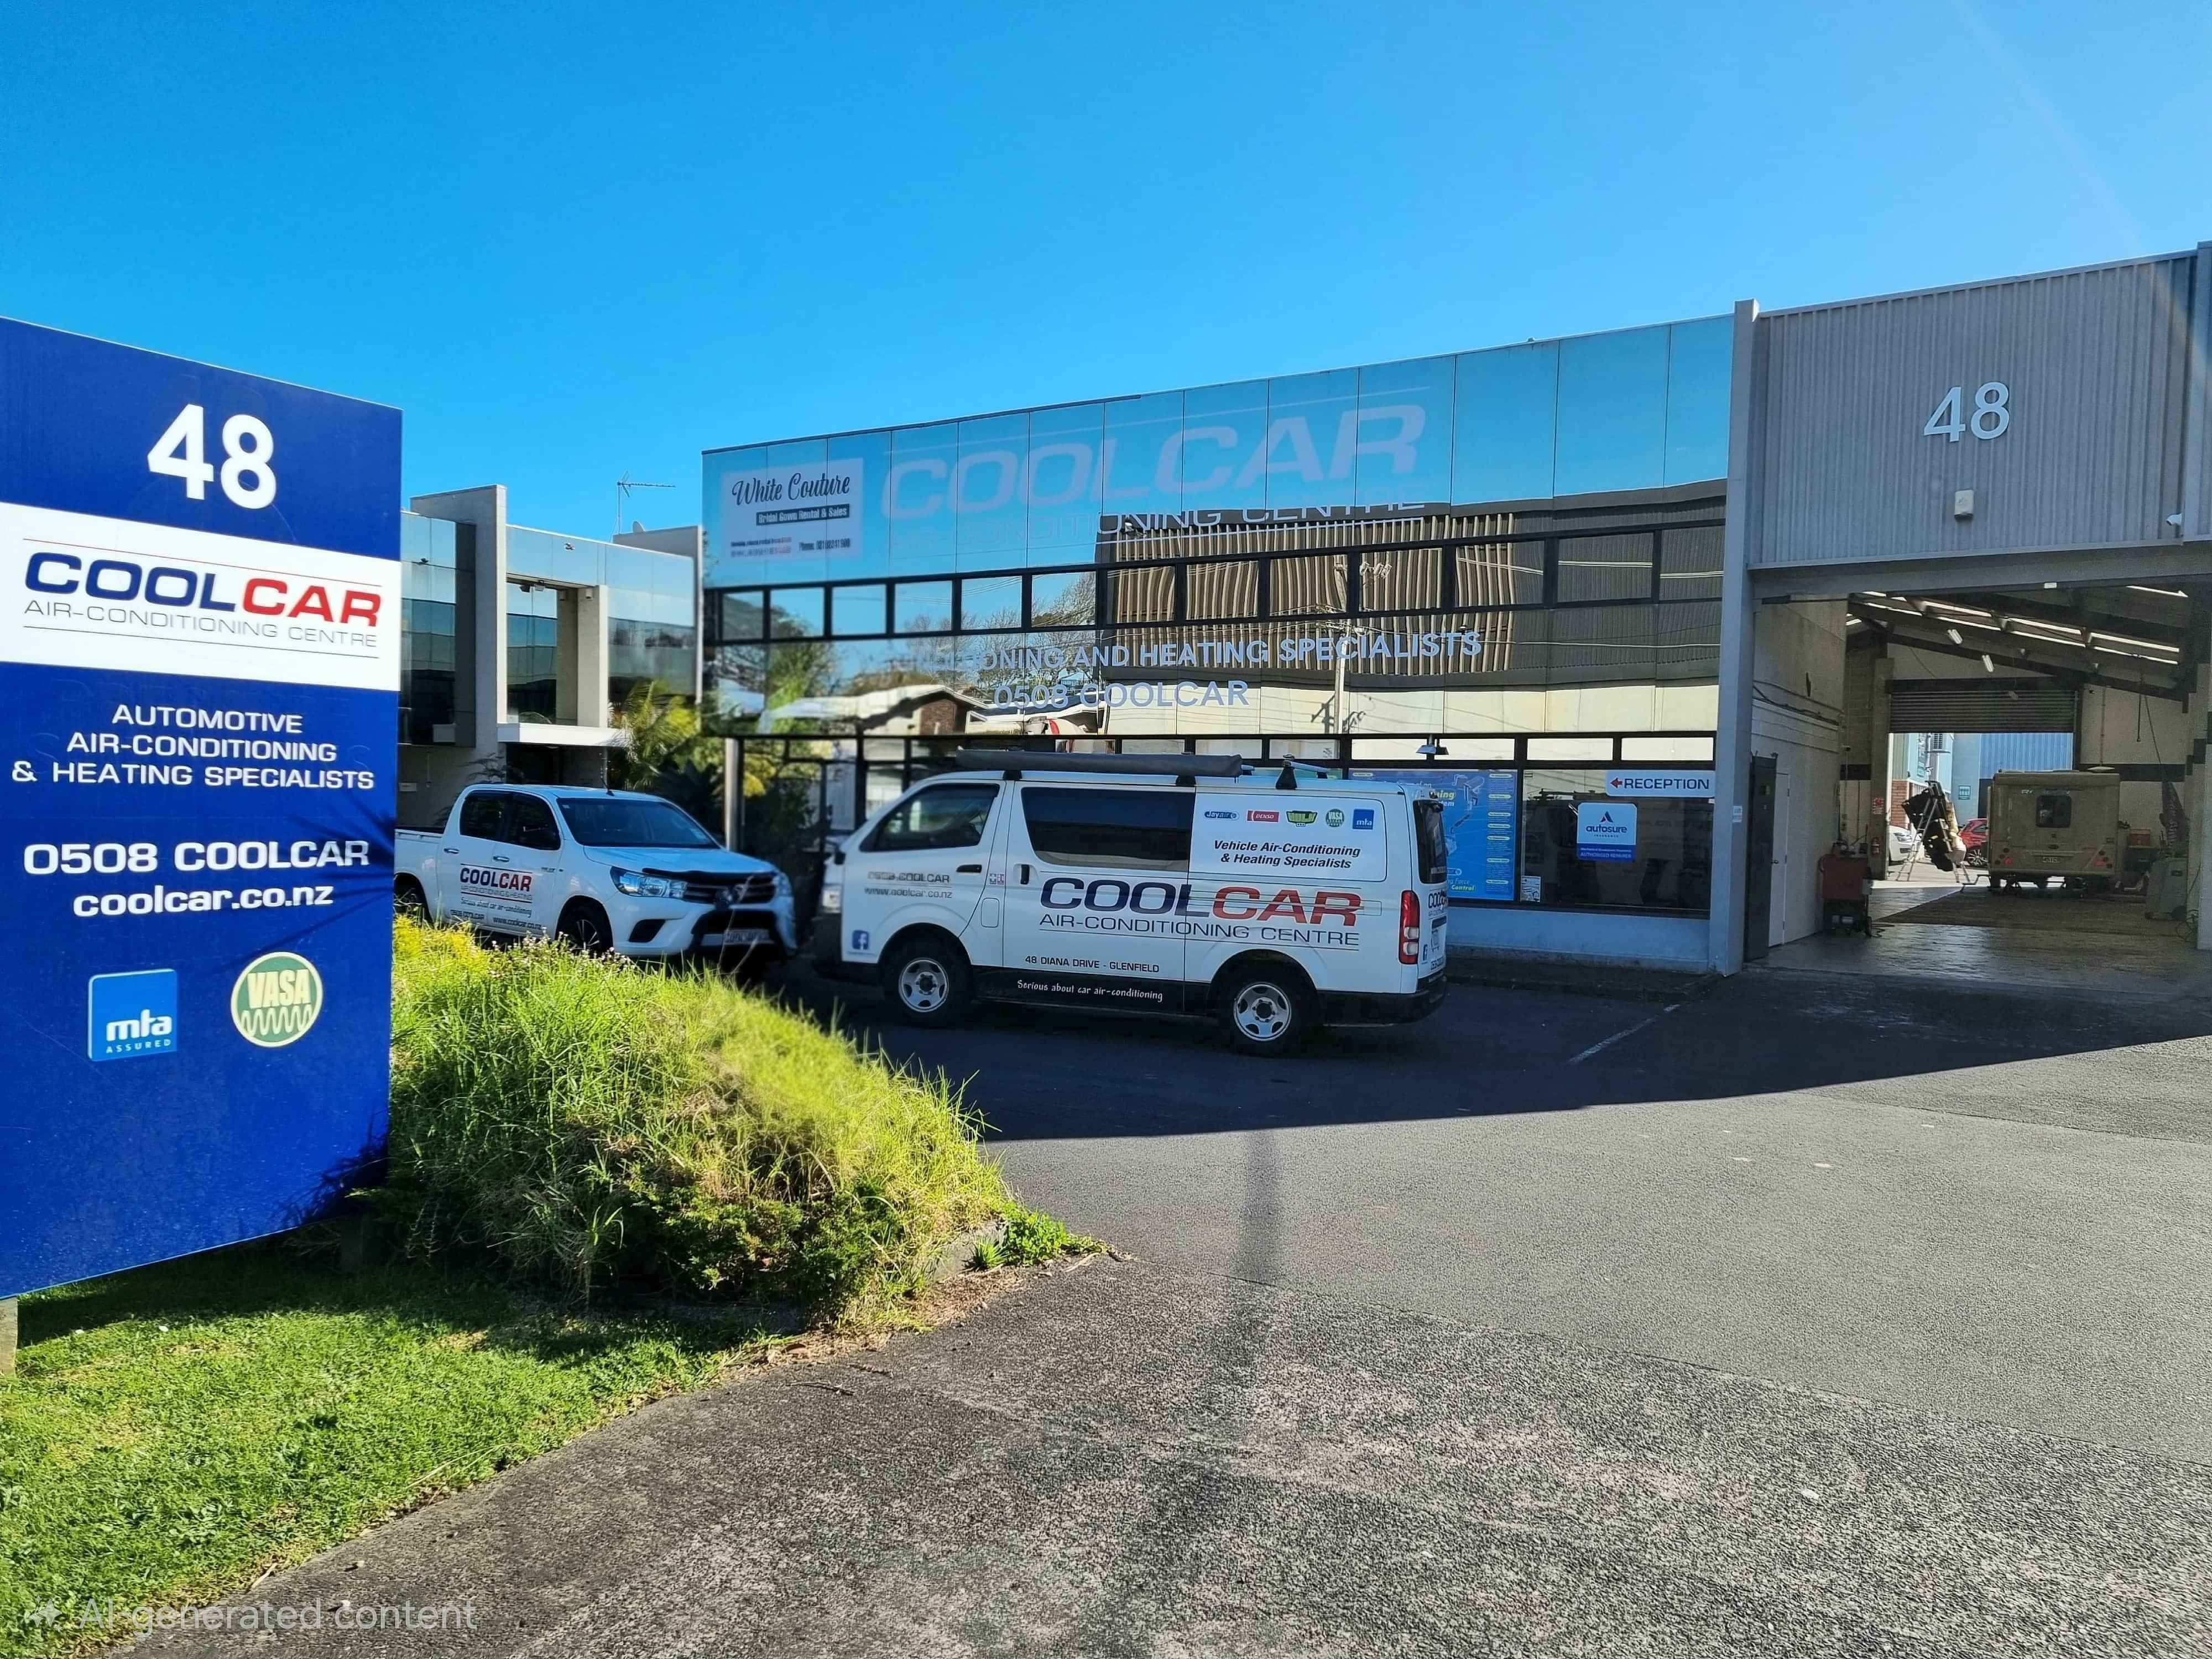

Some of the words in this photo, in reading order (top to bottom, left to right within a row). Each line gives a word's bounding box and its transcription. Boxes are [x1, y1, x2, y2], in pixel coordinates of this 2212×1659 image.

[1923, 381, 2011, 442] 48
[147, 404, 276, 509] 48
[880, 405, 1425, 521] COOLCAR
[732, 477, 782, 505] White
[787, 473, 850, 500] Couture
[829, 507, 847, 517] Sales
[25, 551, 383, 627] COOLCAR
[24, 599, 278, 638] AIR-CONDITIONING
[288, 625, 377, 648] CENTRE
[1073, 644, 1129, 667] AND
[1140, 640, 1269, 665] HEATING
[1279, 631, 1482, 661] SPECIALISTS
[995, 684, 1068, 709] 0508
[1079, 680, 1250, 708] COOLCAR
[112, 704, 303, 733] AUTOMOTIVE
[66, 732, 337, 762] AIR-CONDITIONING
[12, 761, 36, 781] &
[53, 762, 192, 786] HEATING
[204, 766, 374, 789] SPECIALISTS
[1624, 778, 1709, 789] RECEPTION
[1328, 811, 1343, 820] VASA
[1586, 824, 1627, 833] autosure
[23, 842, 158, 875] 0508
[174, 840, 370, 872] COOLCAR
[1214, 840, 1258, 851] Vehicle
[1260, 842, 1361, 858] Air-Conditioning
[1221, 853, 1230, 862] &
[1234, 854, 1281, 867] Heating
[1284, 855, 1352, 868] Specialists
[460, 868, 532, 891] COOLCAR
[898, 873, 950, 883] COOLCAR
[73, 885, 334, 917] coolcar.co.nz
[1040, 877, 1363, 927] COOLCAR
[1039, 912, 1250, 938] AIR-CONDITIONING
[1261, 927, 1359, 946] CENTRE
[1025, 956, 1036, 964] 48
[1041, 957, 1070, 966] DIANA
[1073, 959, 1099, 968] DRIVE
[1109, 962, 1160, 973] GLENFIELD
[247, 969, 311, 1009] VASA
[1017, 979, 1048, 991] Serious
[1051, 983, 1074, 993] about
[1094, 987, 1164, 1003] air-conditioning
[106, 1008, 172, 1041] mta
[106, 1039, 171, 1053] ASSURED
